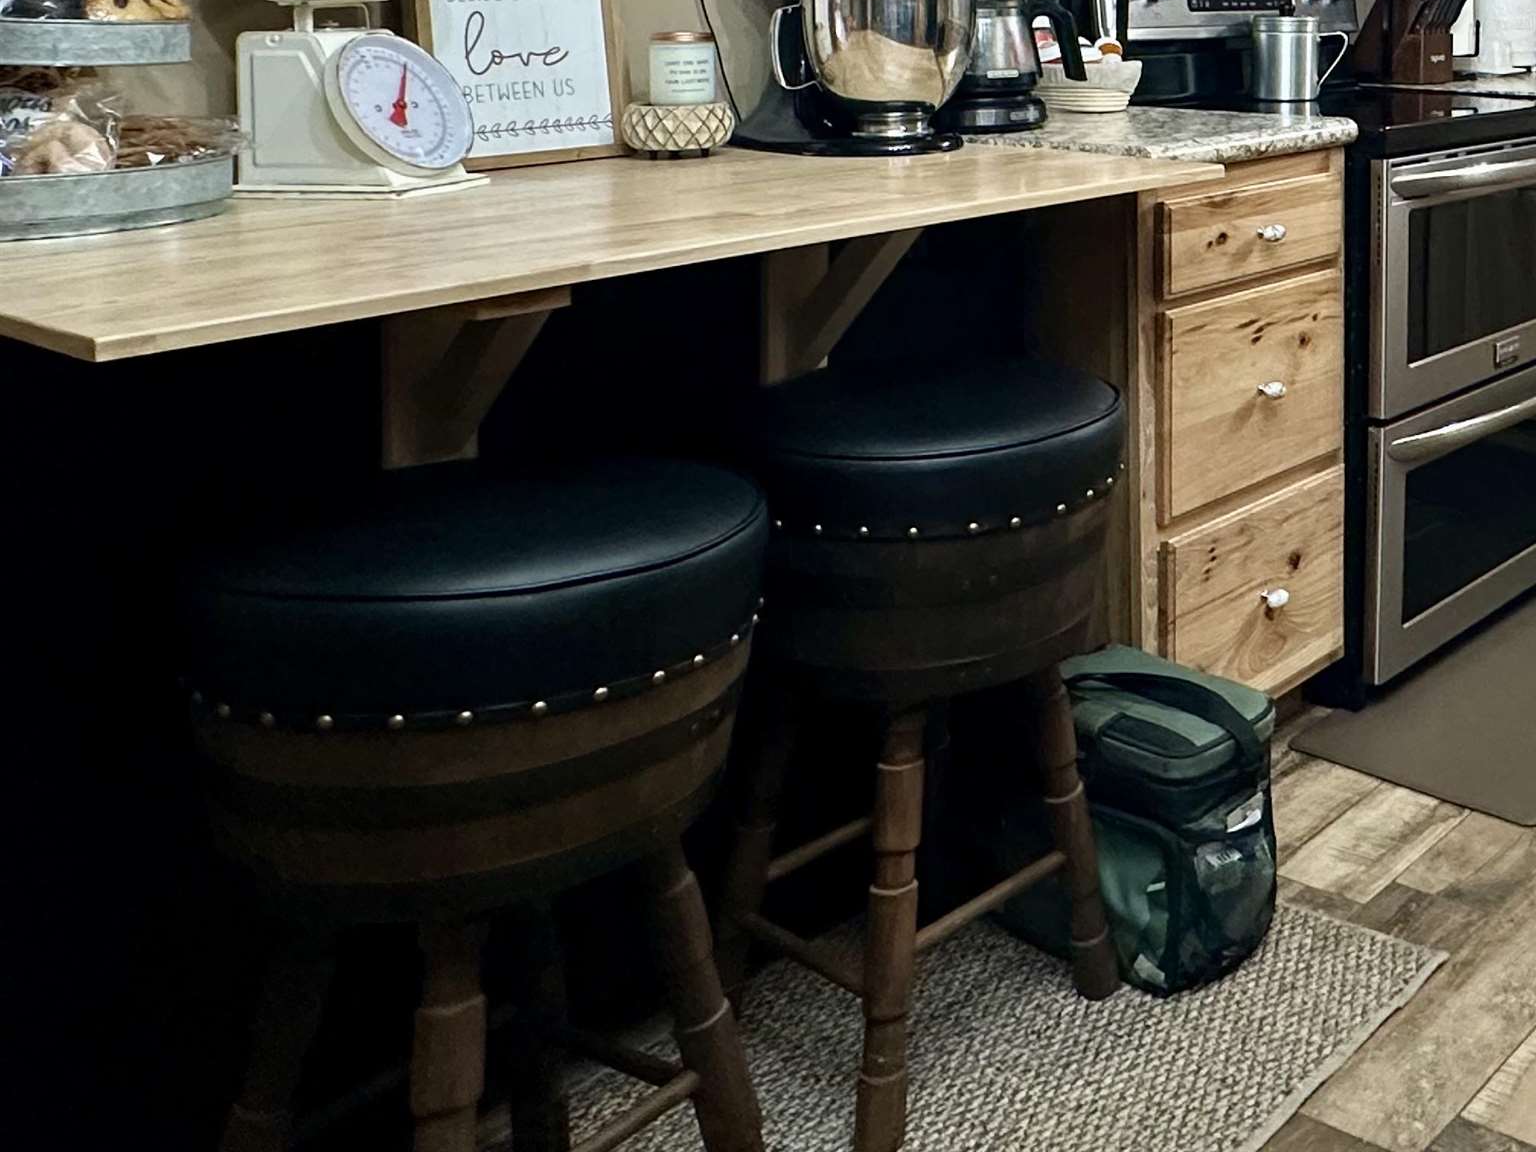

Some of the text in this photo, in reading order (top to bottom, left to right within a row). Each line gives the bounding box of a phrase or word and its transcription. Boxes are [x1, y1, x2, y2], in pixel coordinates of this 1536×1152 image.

[464, 10, 569, 75] love
[463, 78, 575, 105] BETWEEN US
